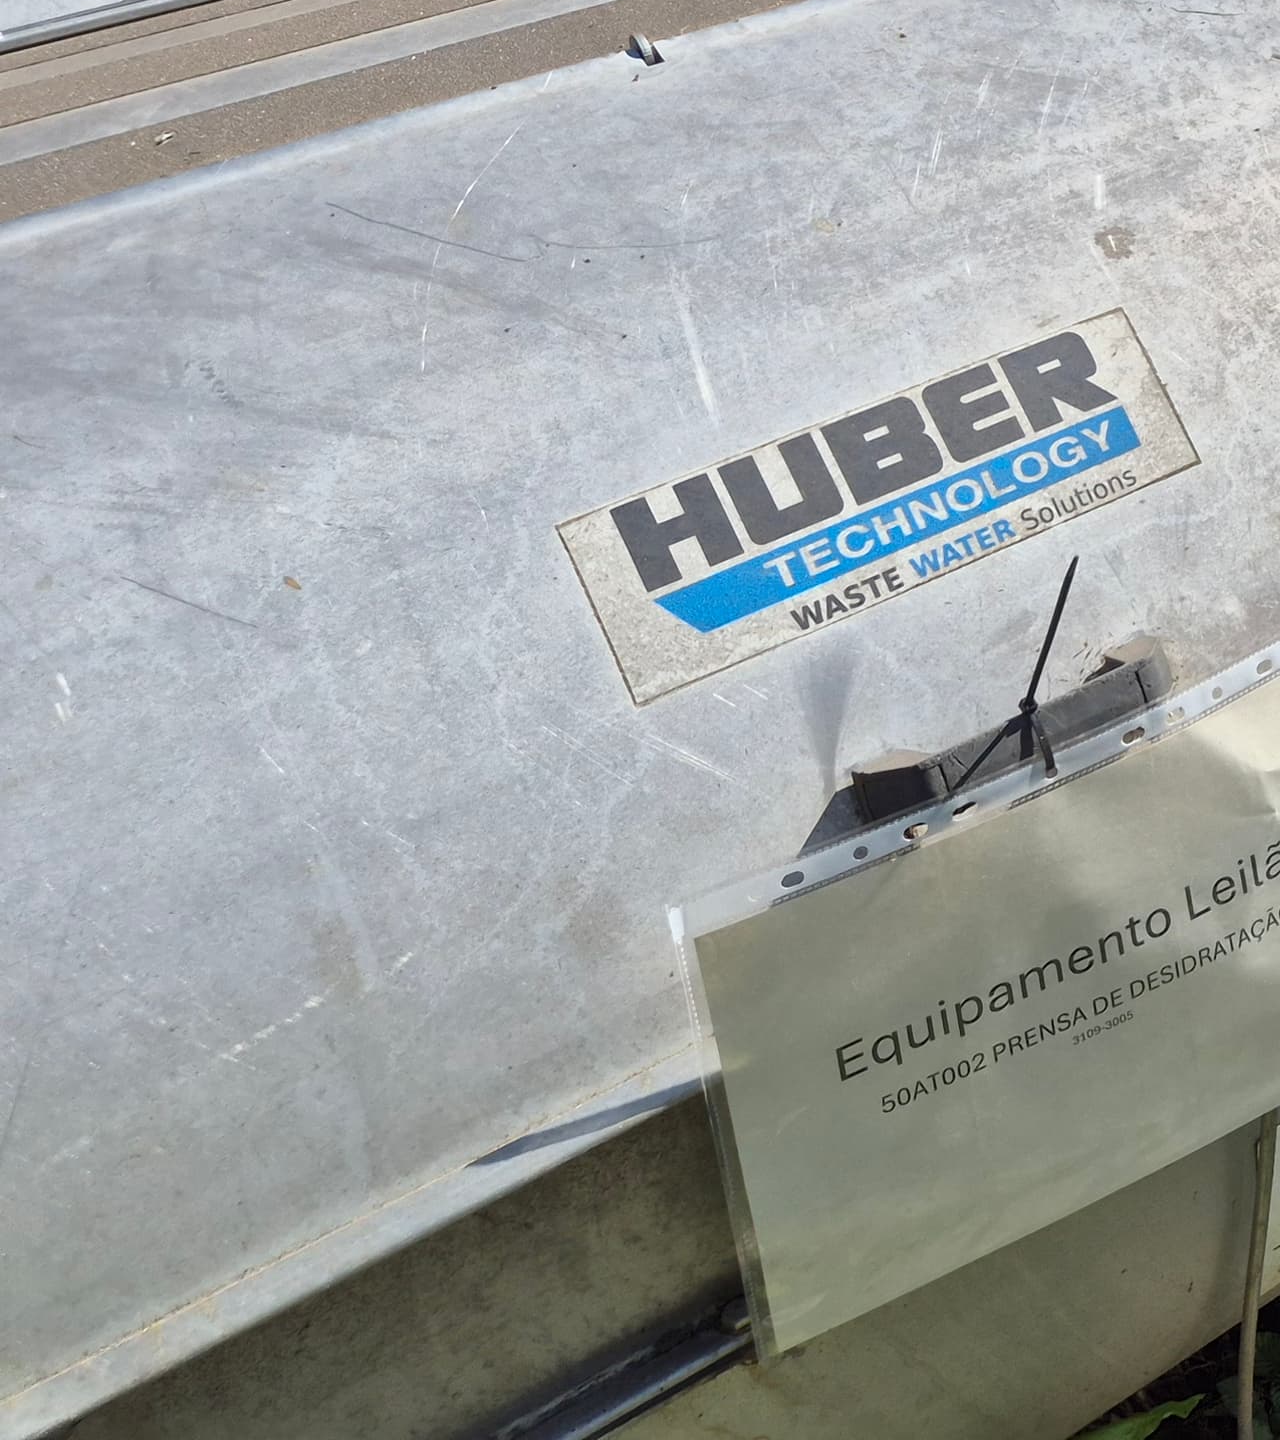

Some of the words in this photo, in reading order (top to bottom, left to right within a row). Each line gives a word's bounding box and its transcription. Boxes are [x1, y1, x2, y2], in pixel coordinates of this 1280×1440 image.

[609, 331, 1119, 593] HUBER
[763, 419, 1116, 588] TECHNOLOGY
[790, 567, 904, 631] WASTE
[909, 518, 1017, 578] WATER
[1020, 468, 1138, 531] Solutions
[834, 907, 1172, 1081] Equipamento
[881, 1052, 988, 1114] 50AT002
[993, 1006, 1088, 1063] PRENSA
[1093, 988, 1124, 1016] DE
